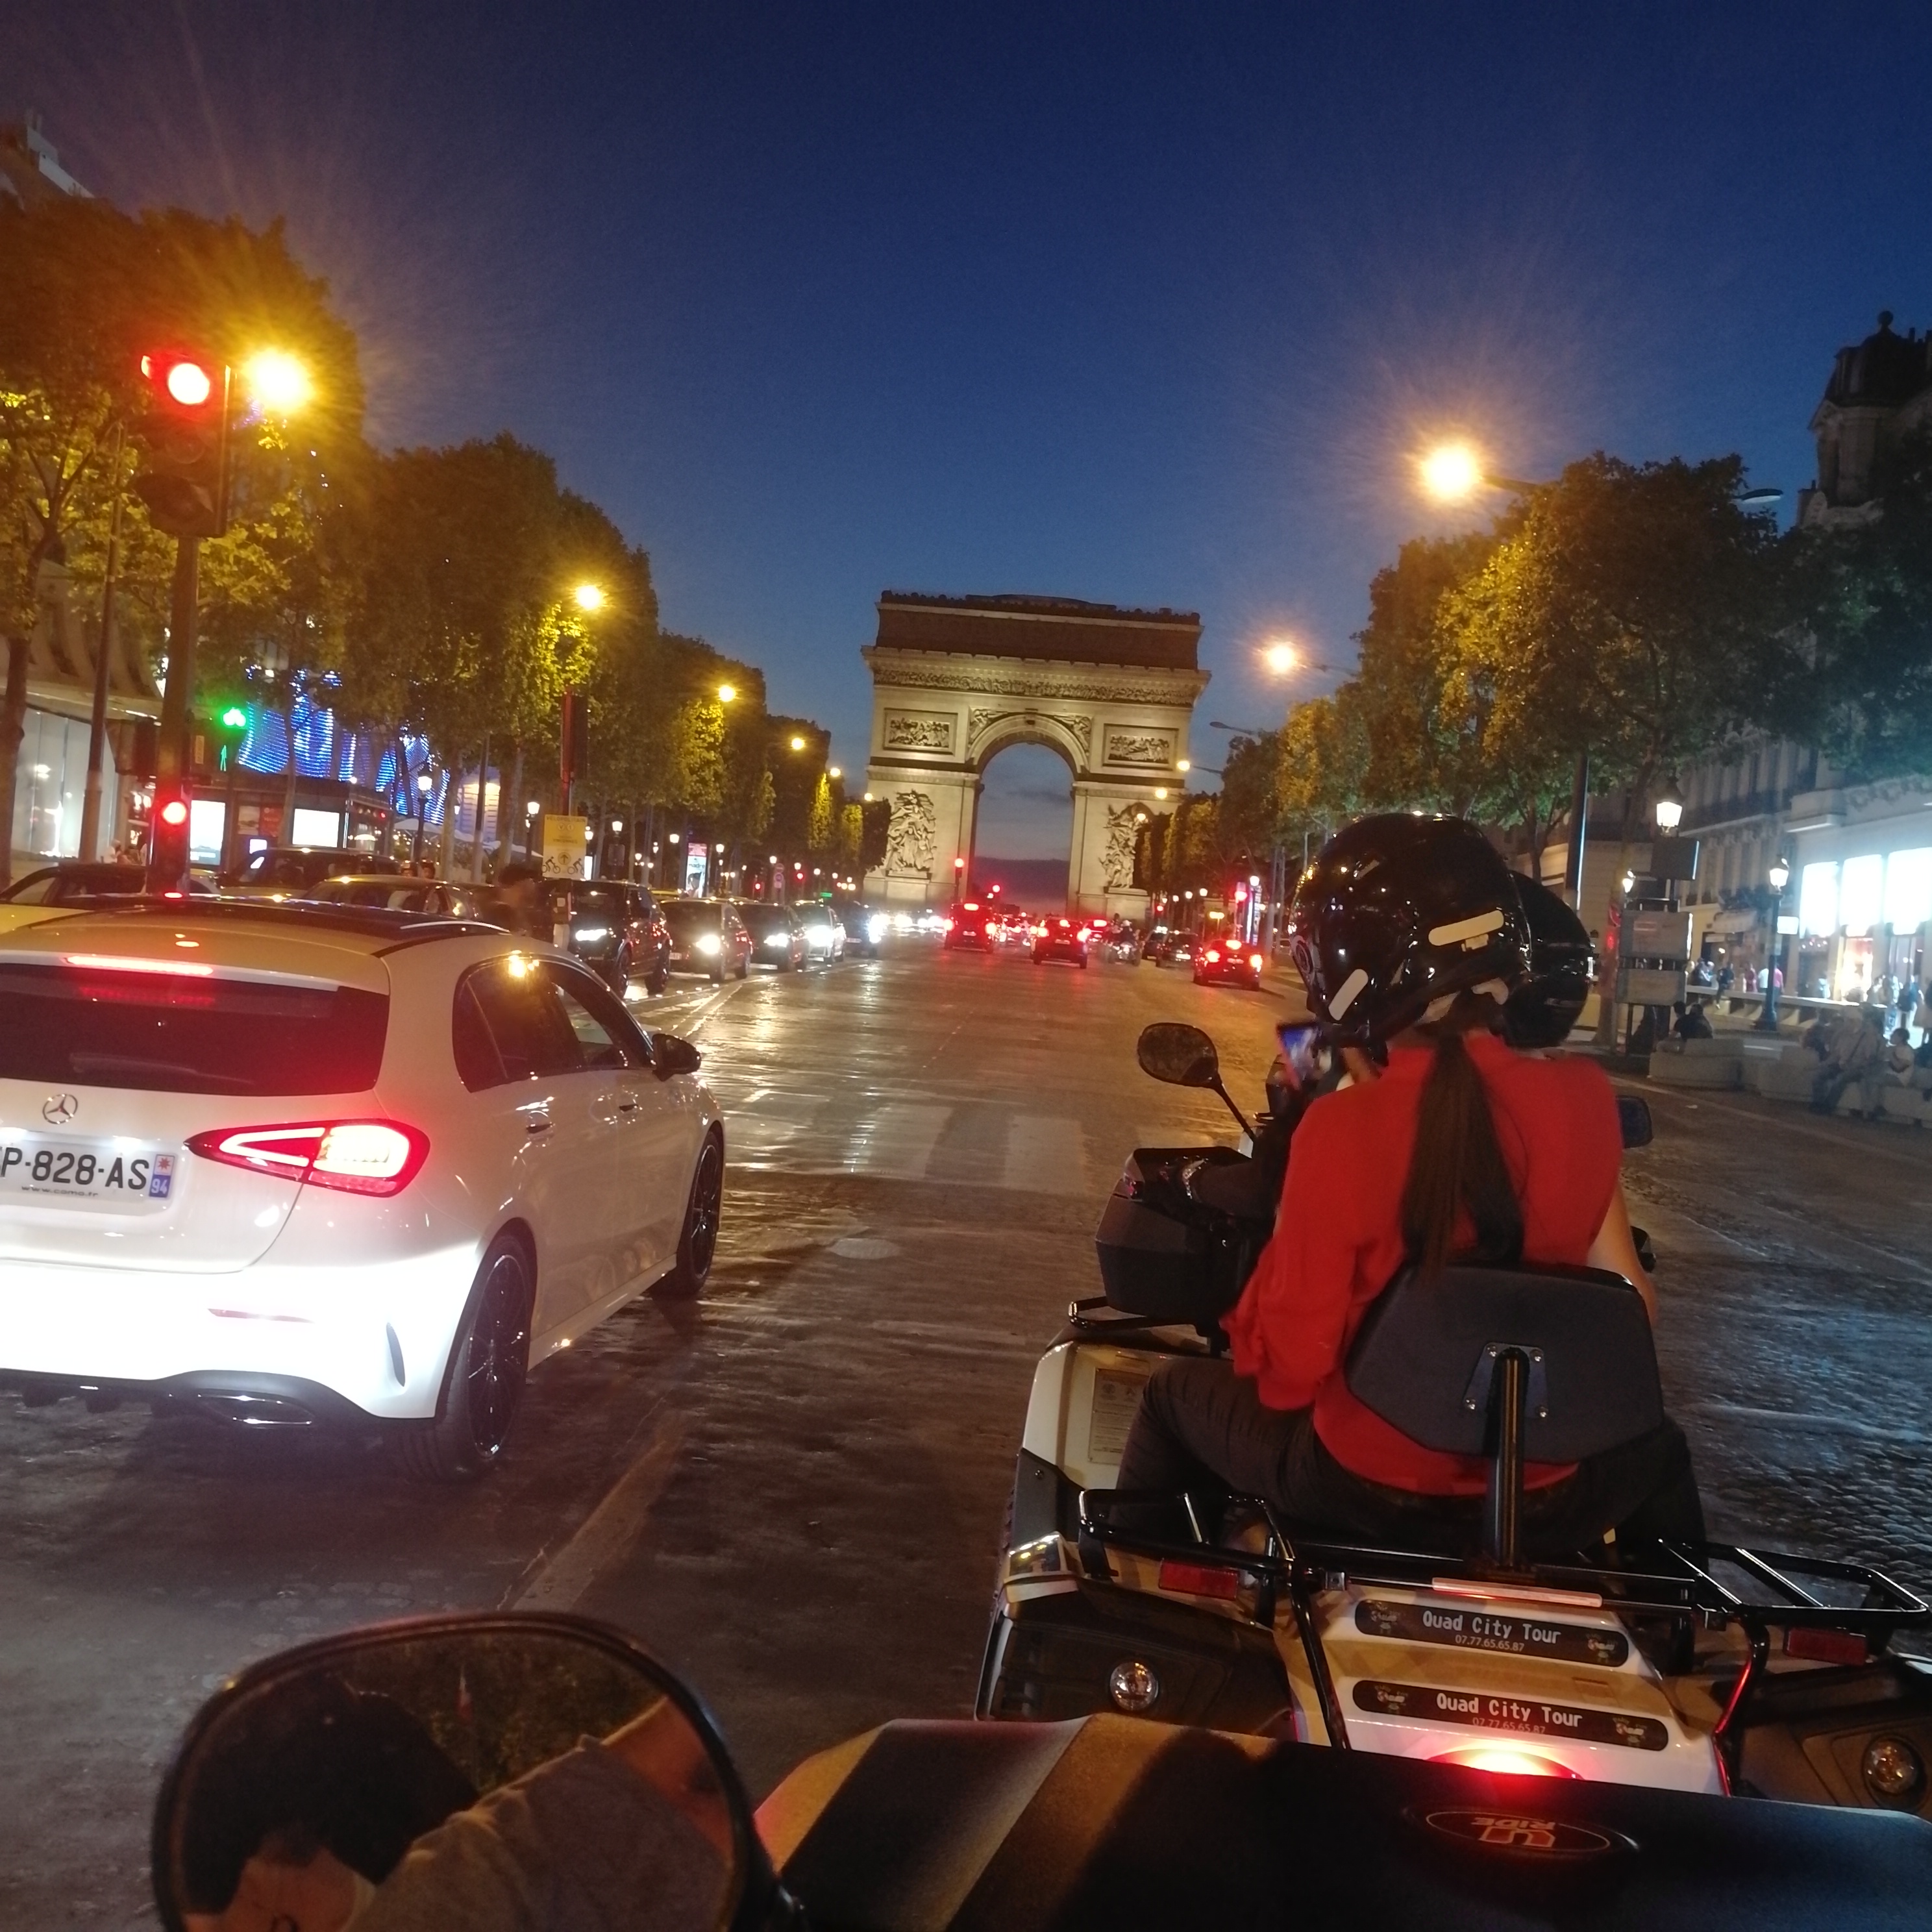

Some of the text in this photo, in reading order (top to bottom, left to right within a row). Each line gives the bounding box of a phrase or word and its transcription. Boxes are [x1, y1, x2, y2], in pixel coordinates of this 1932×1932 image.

[0, 1146, 149, 1190] P-828-AS
[151, 1178, 167, 1195] 94
[1422, 1610, 1463, 1631] Quad
[1472, 1616, 1512, 1639] City
[1522, 1623, 1561, 1644] Tour
[1455, 1634, 1524, 1652] 07.77.65.65.87
[1437, 1692, 1583, 1728] Quad City Tour
[1470, 1817, 1555, 1830] RIDE
